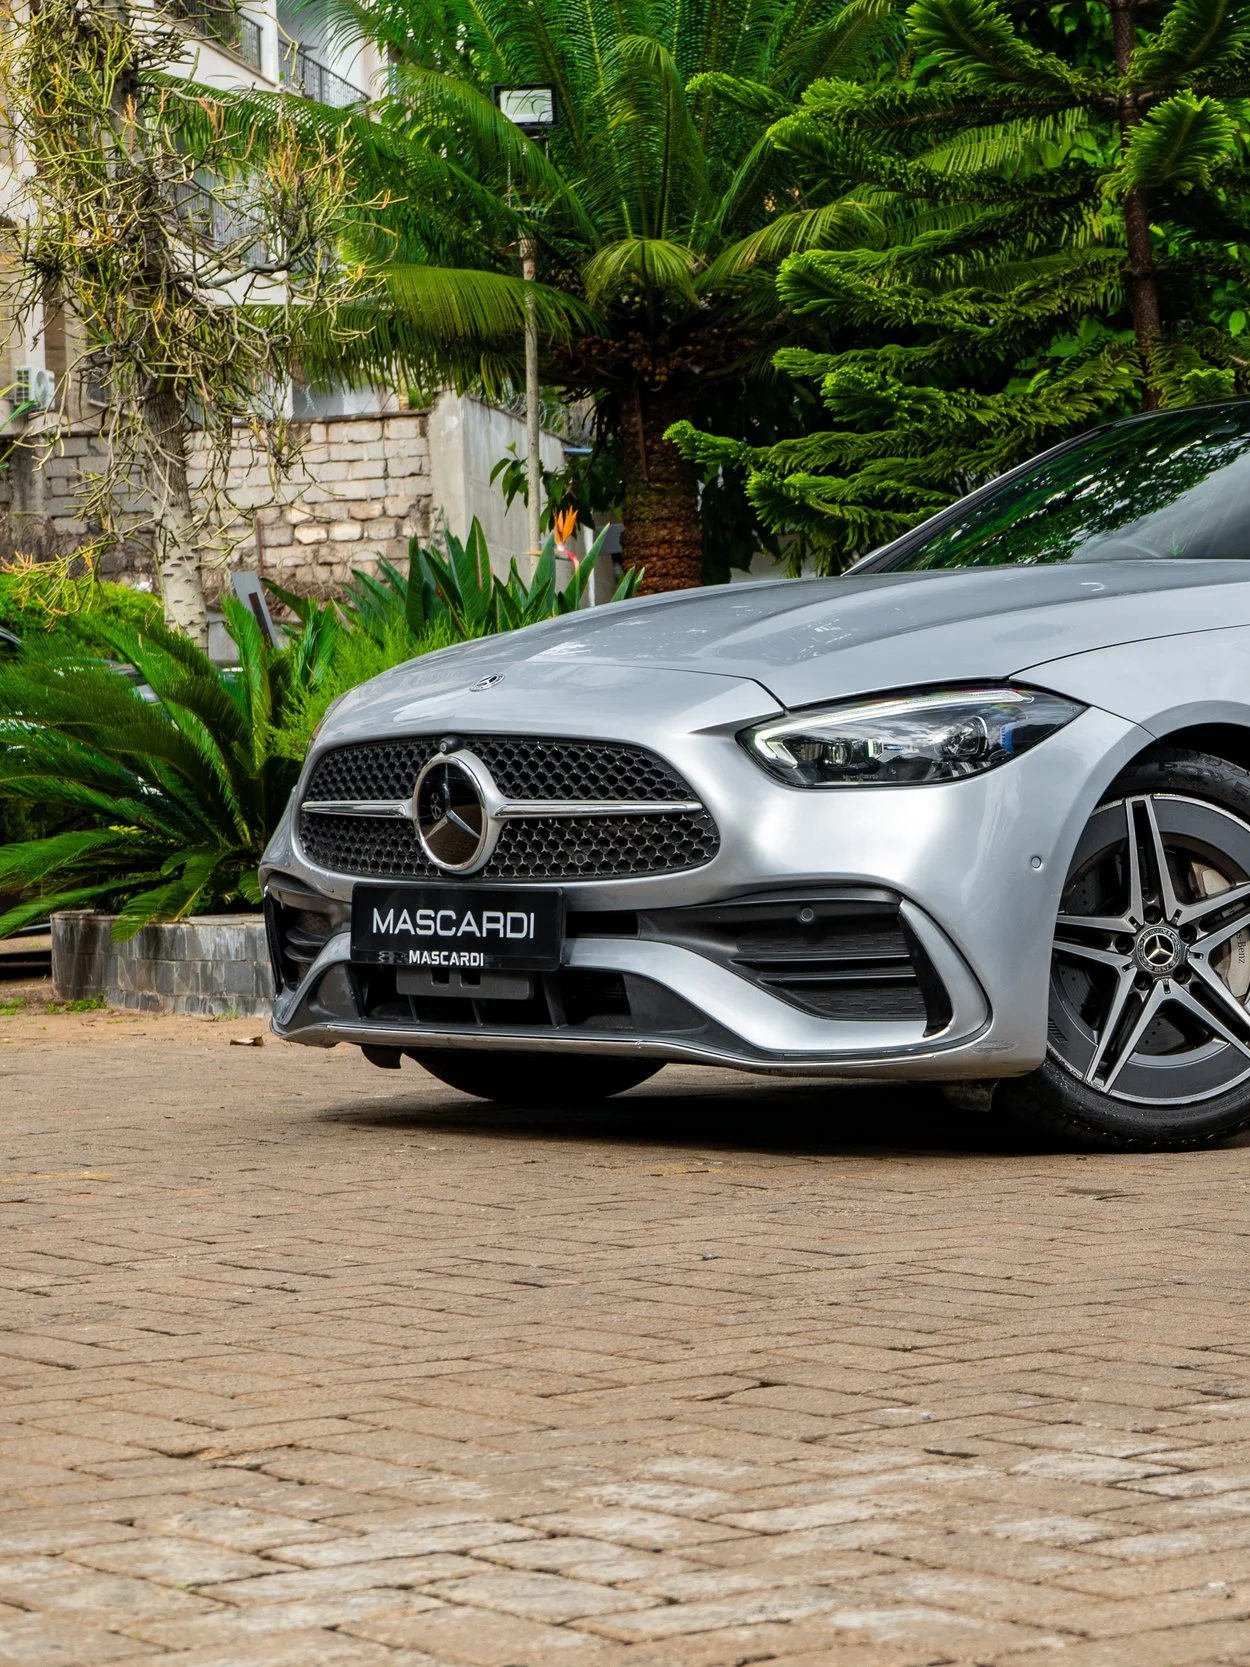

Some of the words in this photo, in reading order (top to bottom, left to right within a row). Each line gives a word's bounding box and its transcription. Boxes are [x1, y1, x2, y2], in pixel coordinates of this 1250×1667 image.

[372, 907, 535, 939] MASCARDI
[408, 949, 484, 967] MASCARDI
[1236, 932, 1246, 964] s-Benz
